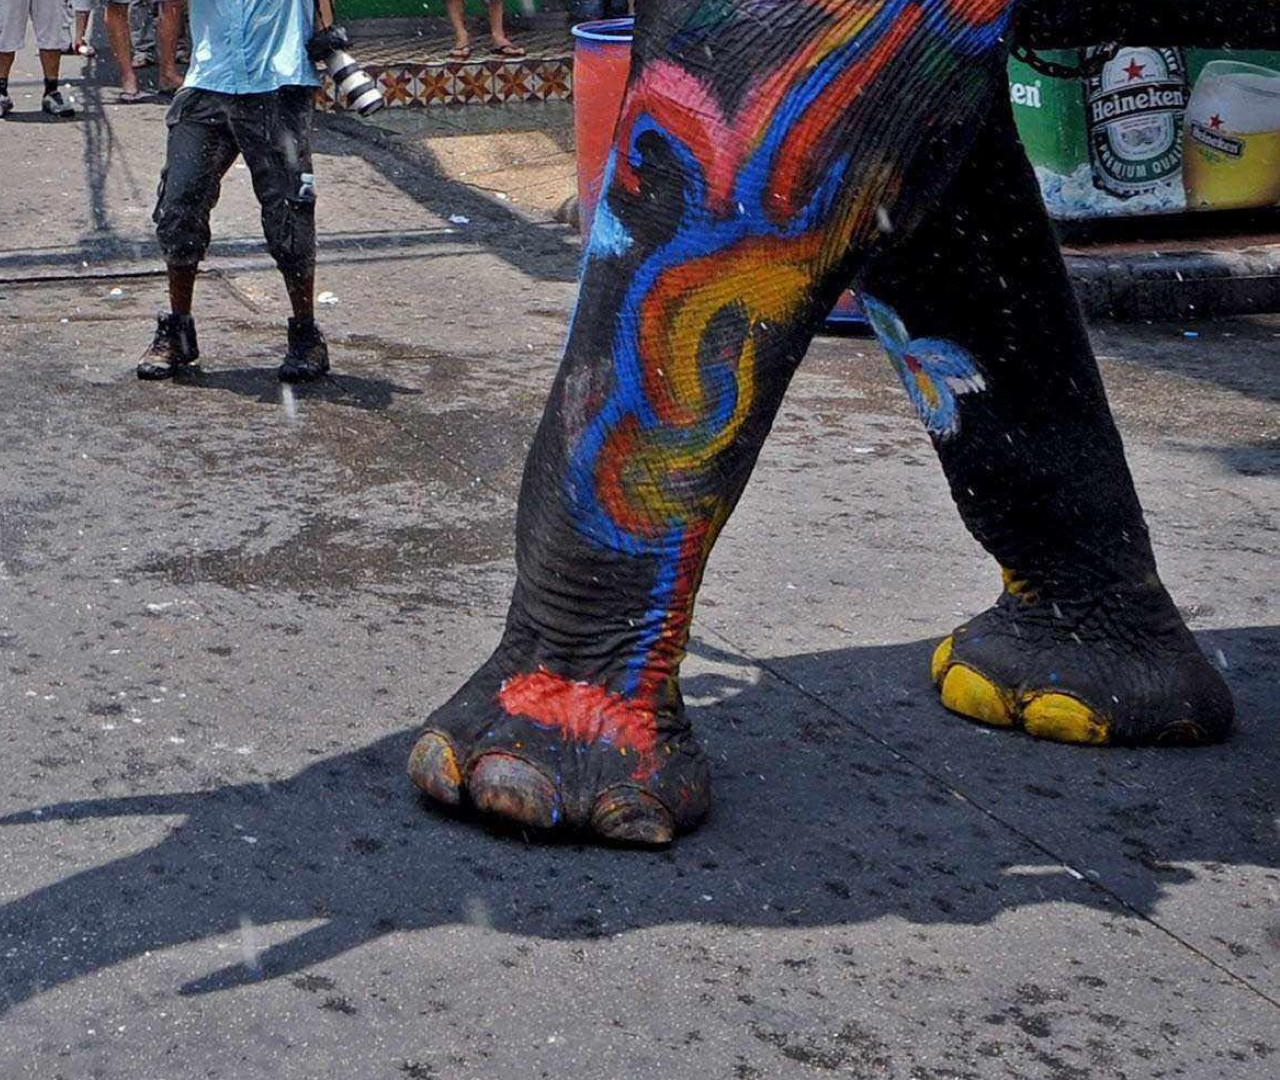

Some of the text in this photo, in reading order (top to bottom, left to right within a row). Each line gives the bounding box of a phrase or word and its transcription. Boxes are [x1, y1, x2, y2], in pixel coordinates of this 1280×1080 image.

[1009, 82, 1042, 108] en
[1091, 87, 1186, 123] Heineken
[1098, 143, 1147, 178] PREMIUM
